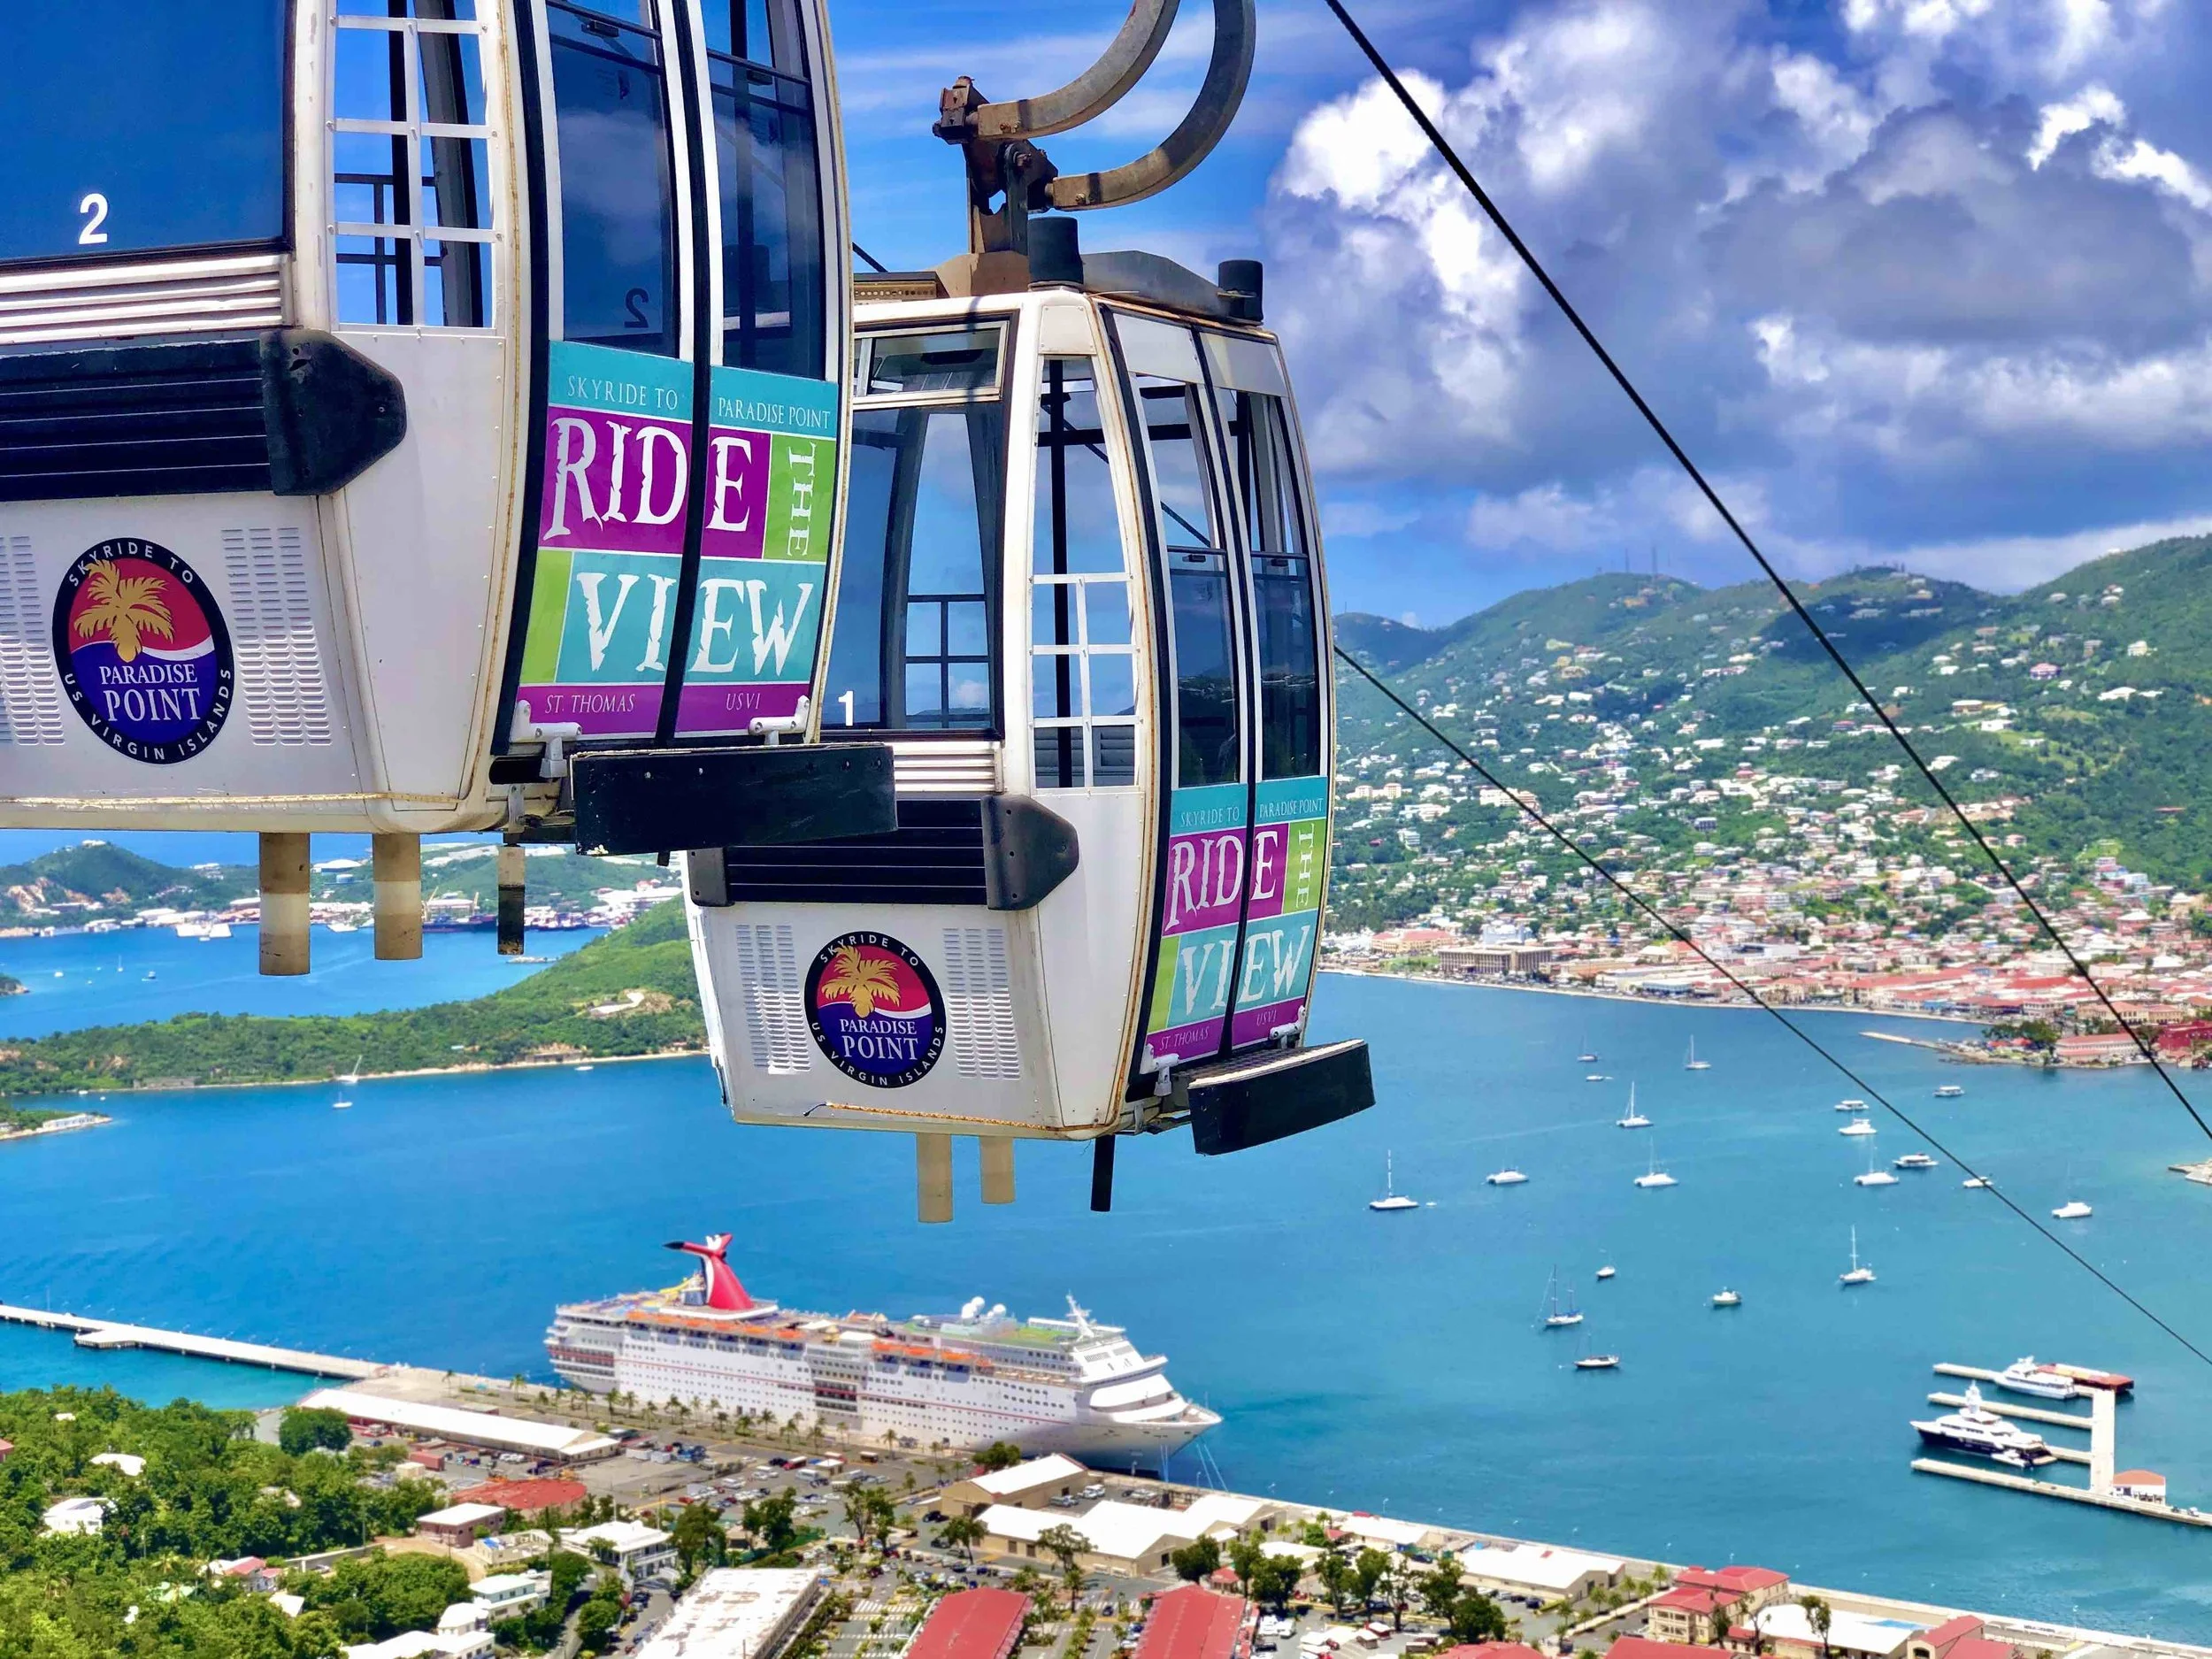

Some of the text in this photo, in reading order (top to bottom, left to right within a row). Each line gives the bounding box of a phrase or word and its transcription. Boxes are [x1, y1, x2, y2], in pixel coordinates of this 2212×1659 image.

[79, 193, 108, 244] 2
[567, 375, 831, 429] SKYRIDE TO PARADISE POINT
[543, 417, 752, 541] RIDE
[787, 442, 816, 557] THE
[69, 541, 194, 587] SKYRIDE TO
[576, 572, 813, 677] VIEW
[99, 664, 198, 685] PARADISE
[65, 669, 232, 761] US VIRGIN ISLANDS
[103, 687, 201, 722] POINT
[571, 693, 635, 713] THOMAS
[726, 694, 761, 710] USVI
[838, 691, 854, 726] 1
[1180, 798, 1324, 829] SKYRIDE TO PARADISE POINT
[1165, 831, 1278, 932] RIDE
[1297, 823, 1315, 908] THE
[819, 934, 918, 966] SKYRIDE TO
[1180, 925, 1310, 1017] VIEW
[840, 1018, 918, 1035] PARADISE
[842, 1036, 918, 1061] POINT
[1174, 1025, 1209, 1048] THOMAS
[1256, 1010, 1277, 1025] USVI
[811, 1022, 943, 1086] US VIRGIN ISLANDS
